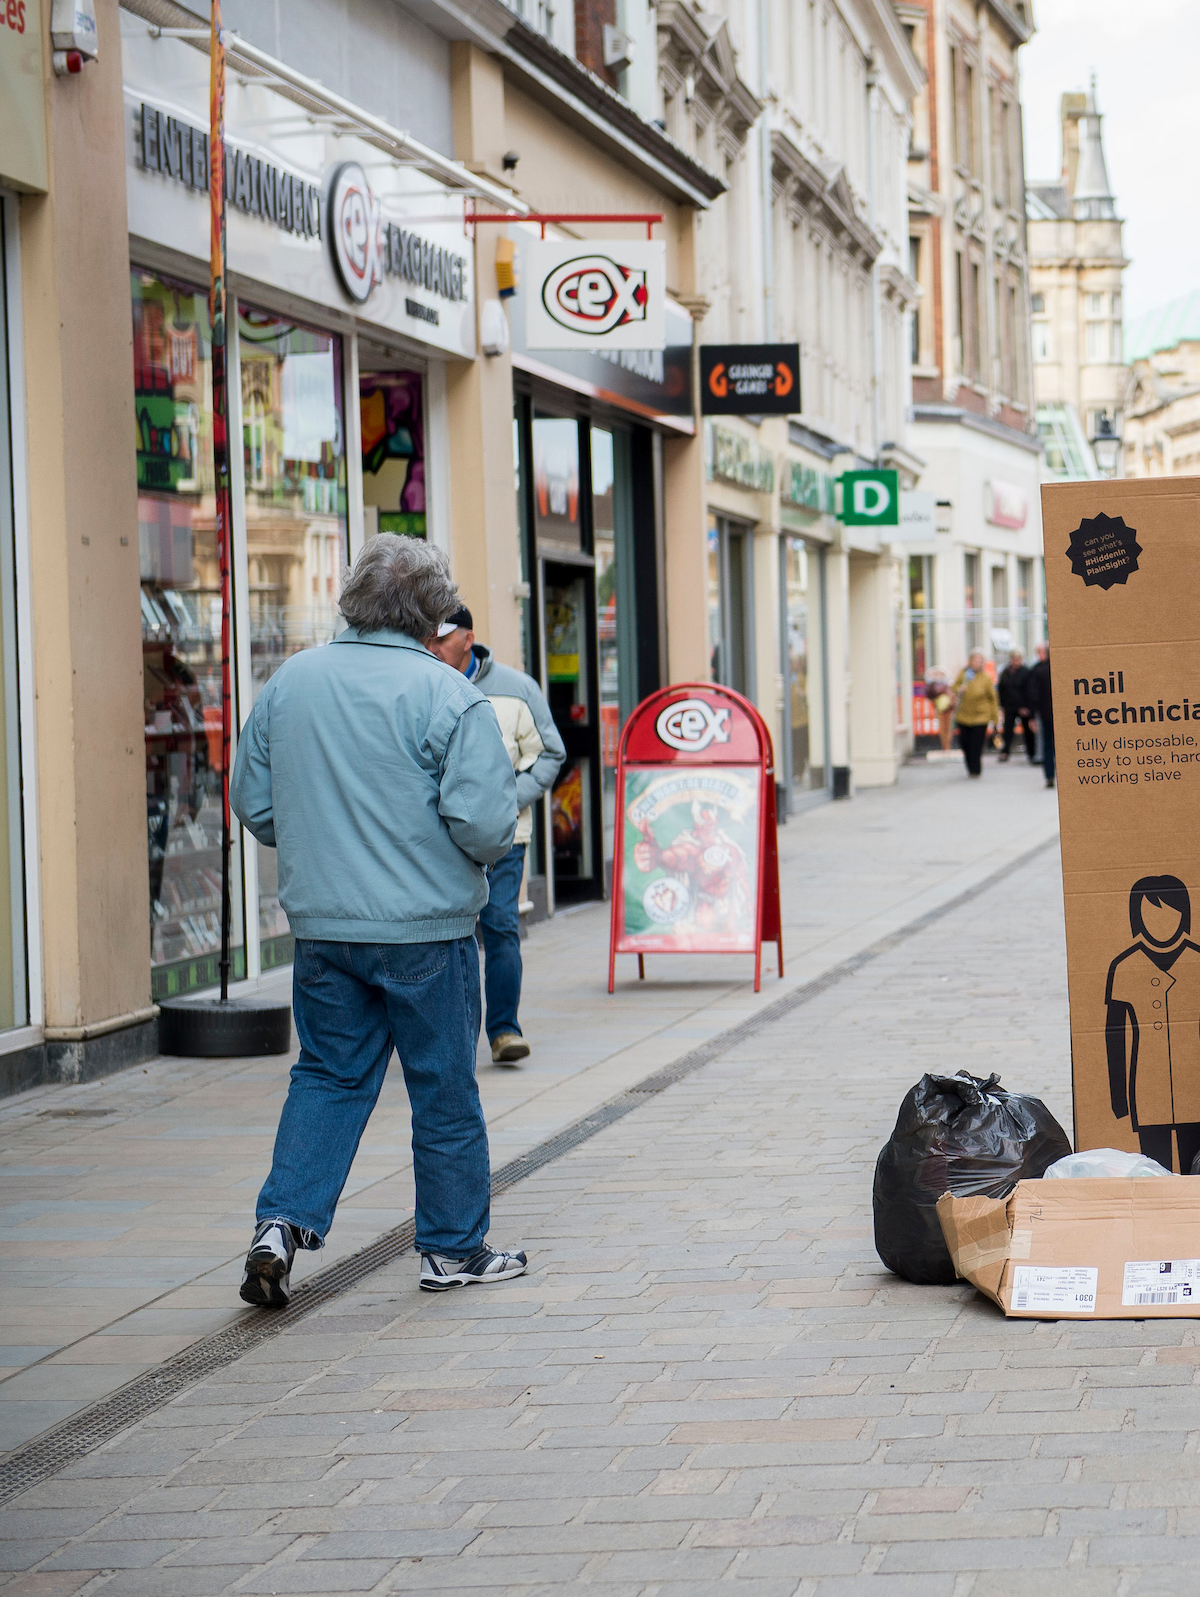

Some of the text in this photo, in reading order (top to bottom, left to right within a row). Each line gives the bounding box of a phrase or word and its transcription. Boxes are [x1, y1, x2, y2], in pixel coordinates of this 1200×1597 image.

[0, 0, 26, 34] es
[385, 222, 468, 303] EXCHANGE
[854, 480, 890, 517] D
[1083, 539, 1123, 557] see what's
[1084, 532, 1115, 546] can you
[1085, 549, 1126, 566] #HiddenIn
[1086, 556, 1130, 576] PlainSight?
[1073, 671, 1124, 695] nail
[1076, 734, 1198, 753] fully disposable,
[1077, 756, 1111, 769] easy
[1116, 754, 1132, 766] to
[1136, 753, 1166, 766] use,
[1078, 769, 1182, 785] working slave
[1075, 1294, 1094, 1302] 0301
